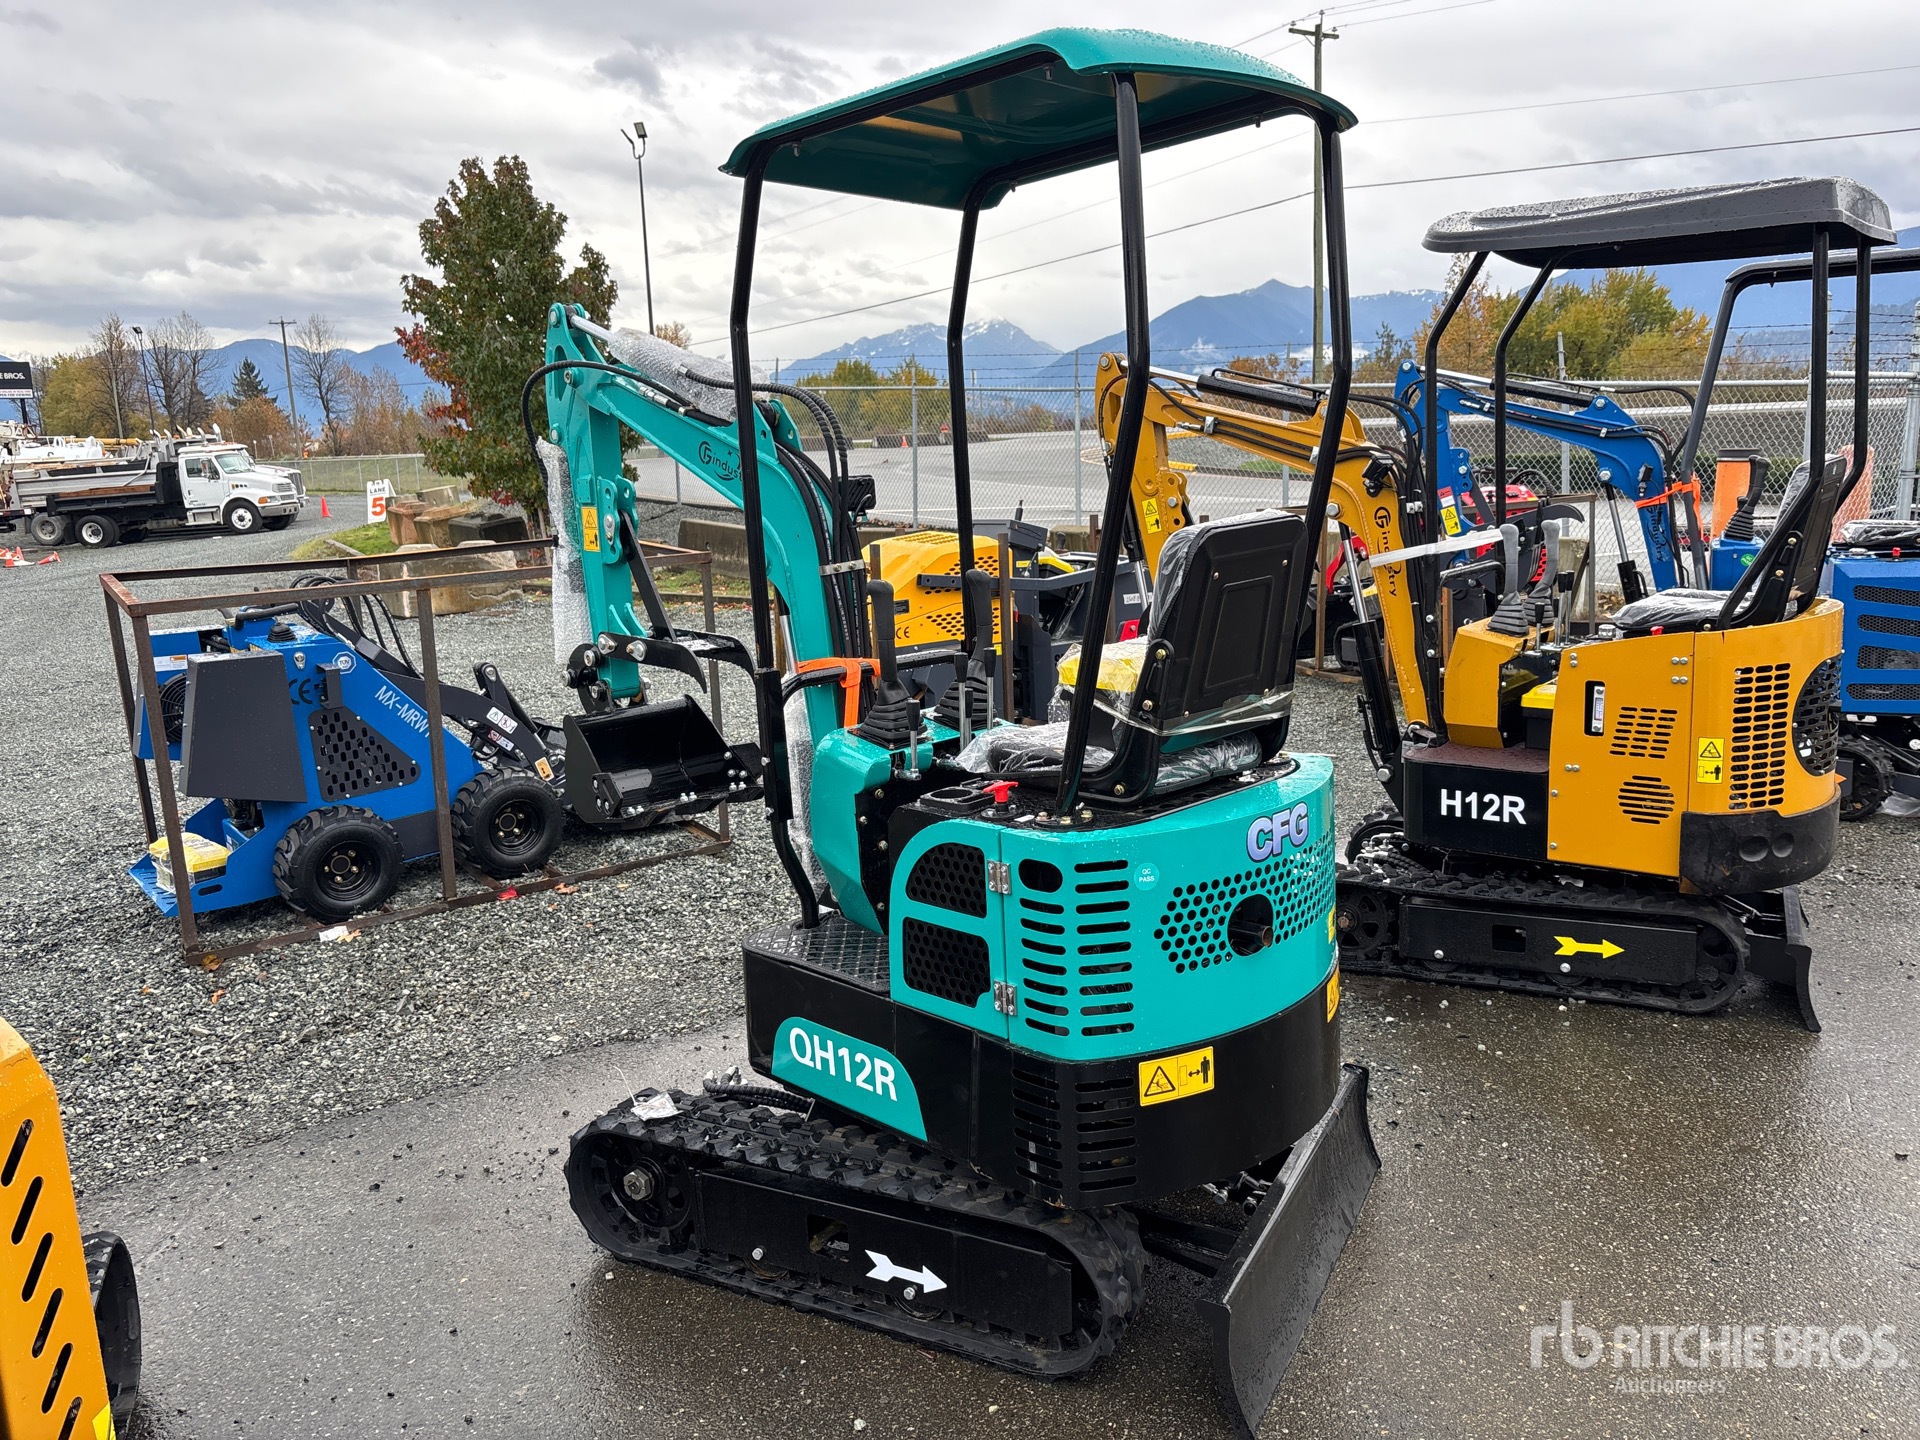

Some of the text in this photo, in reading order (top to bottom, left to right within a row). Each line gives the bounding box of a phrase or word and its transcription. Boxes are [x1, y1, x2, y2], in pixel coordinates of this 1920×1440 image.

[371, 496, 386, 516] 5
[1441, 788, 1527, 825] H12R
[1247, 802, 1309, 862] CFG
[1138, 875, 1155, 883] PASS
[789, 1026, 898, 1102] QH12R
